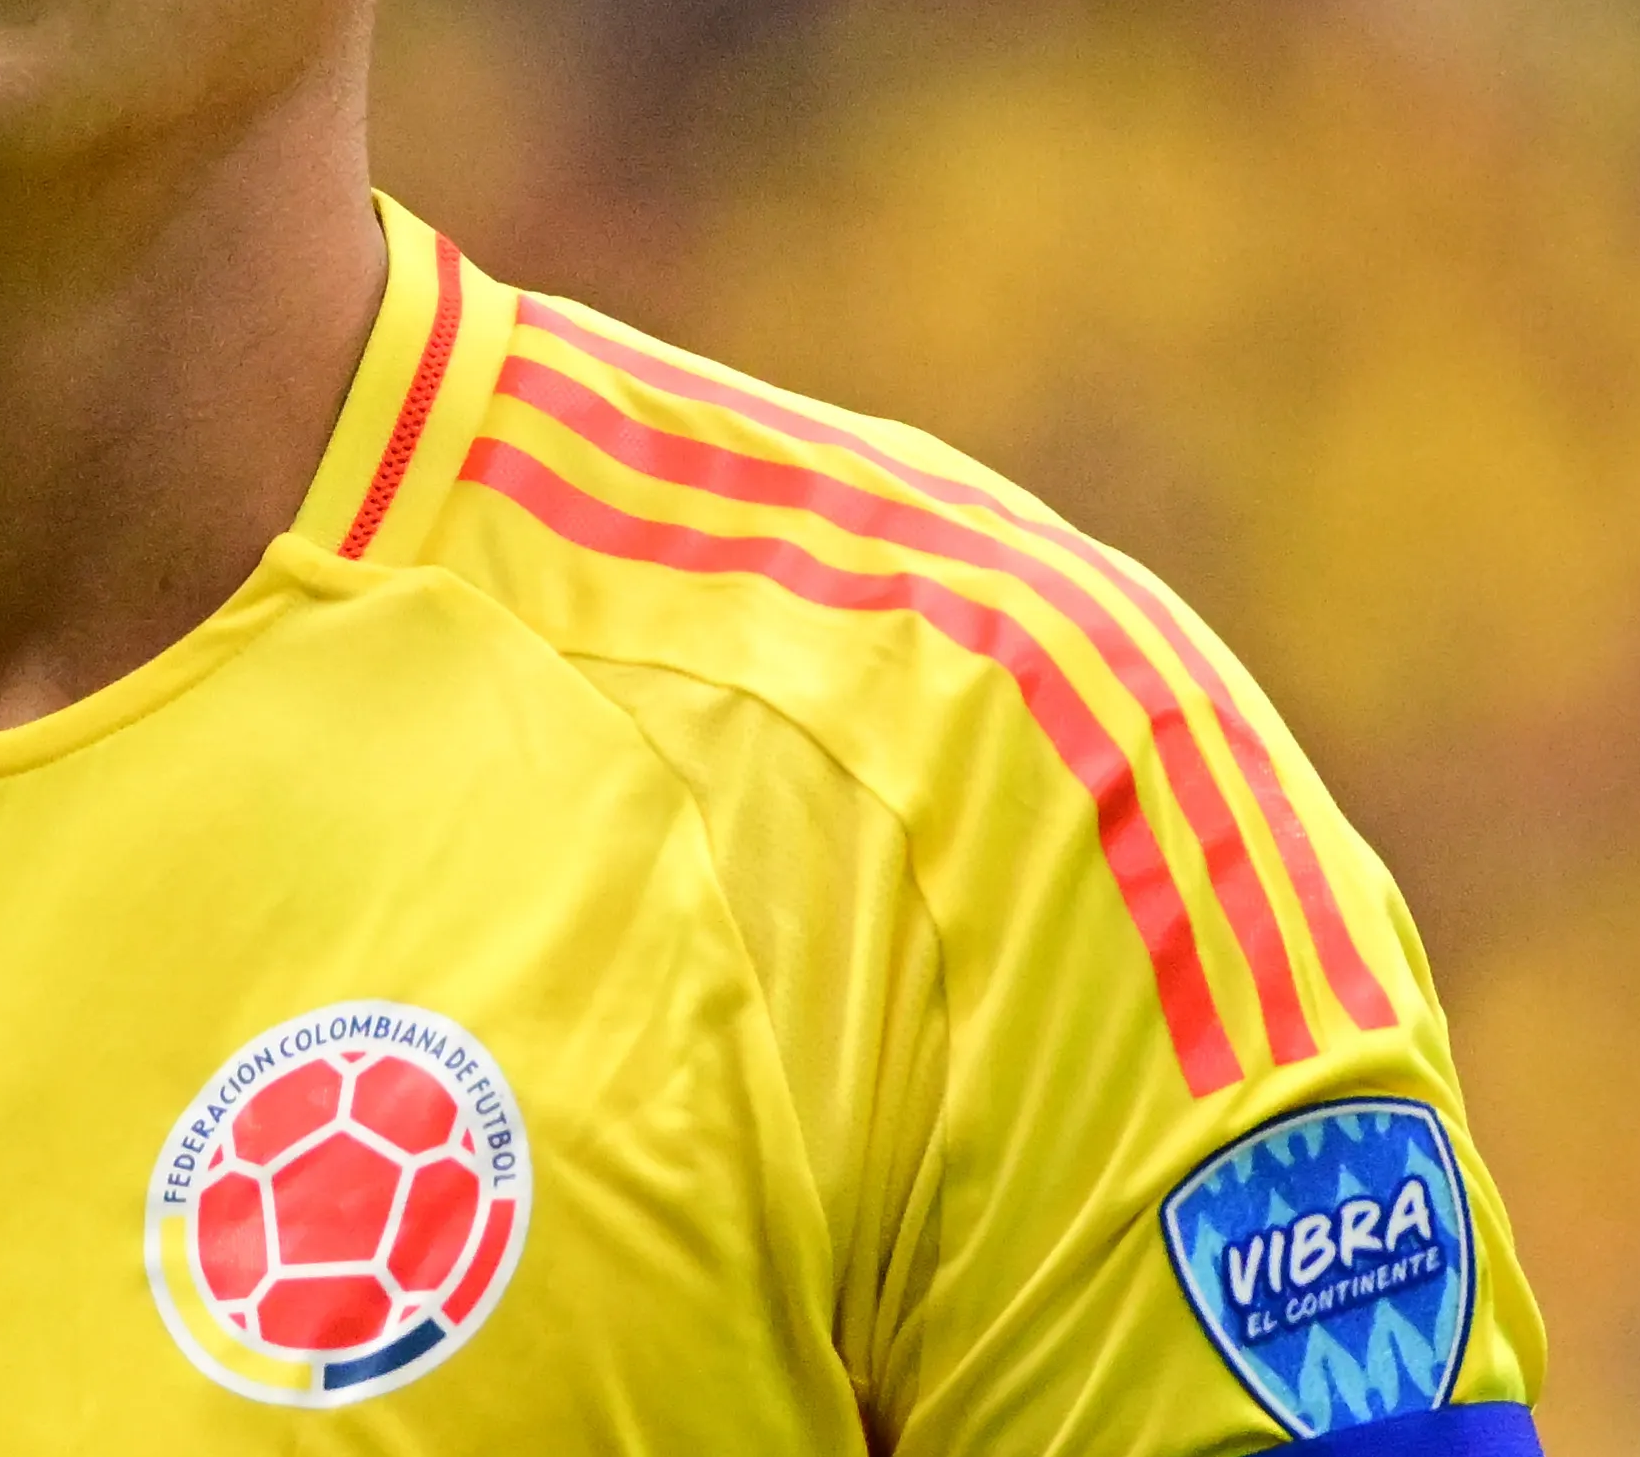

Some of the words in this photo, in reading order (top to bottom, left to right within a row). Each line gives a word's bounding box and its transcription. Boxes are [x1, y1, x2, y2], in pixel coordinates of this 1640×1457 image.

[279, 1015, 448, 1060] COLOMBIANA
[444, 1046, 480, 1082] DE
[1228, 1179, 1432, 1306] VIBRA
[1245, 1310, 1278, 1339] EL
[1284, 1246, 1442, 1323] CONTINENTE
